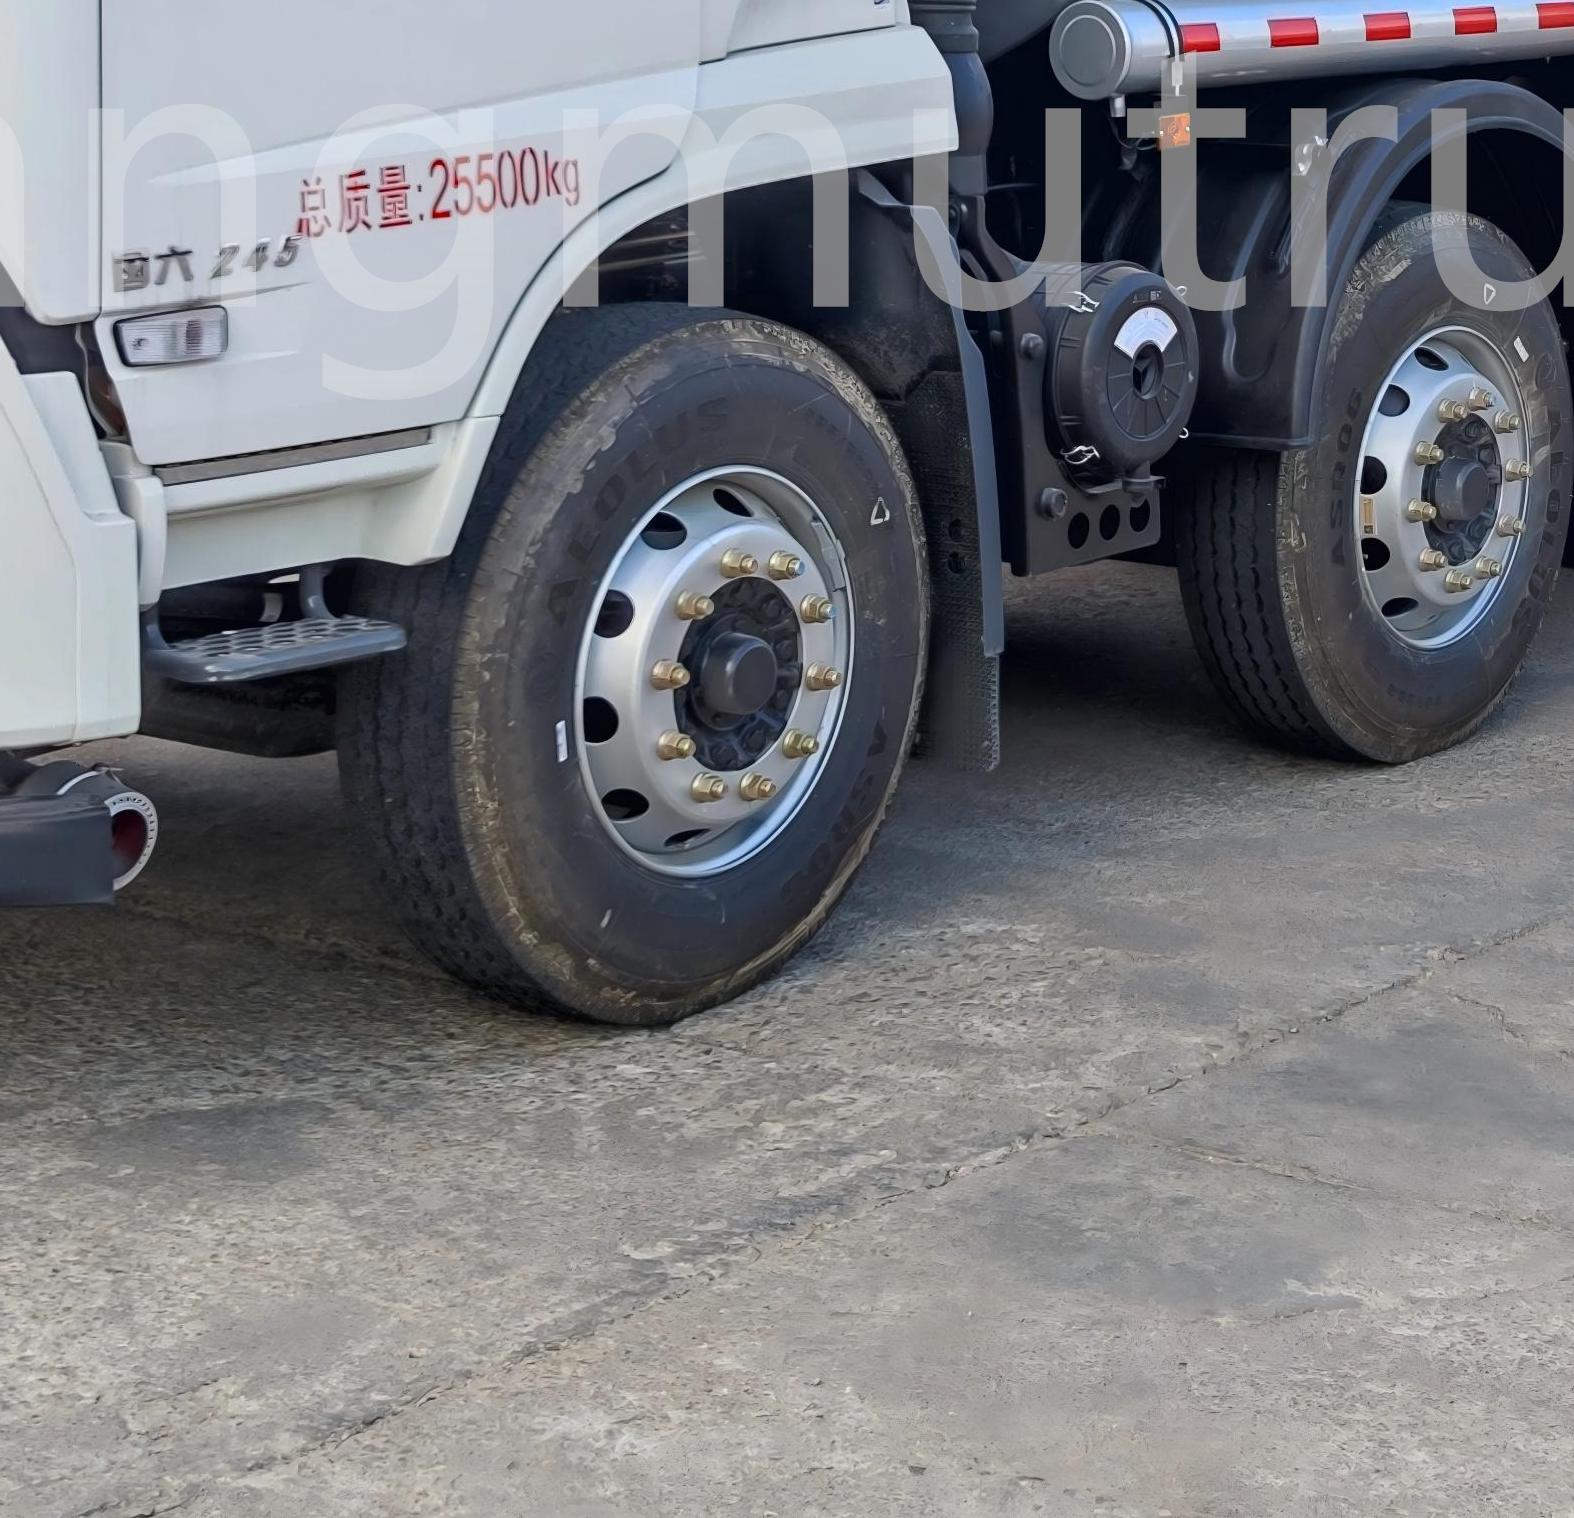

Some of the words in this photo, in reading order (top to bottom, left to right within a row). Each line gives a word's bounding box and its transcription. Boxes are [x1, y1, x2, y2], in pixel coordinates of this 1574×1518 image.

[295, 146, 581, 239] 总质量:25500kg
[210, 234, 304, 280] 245
